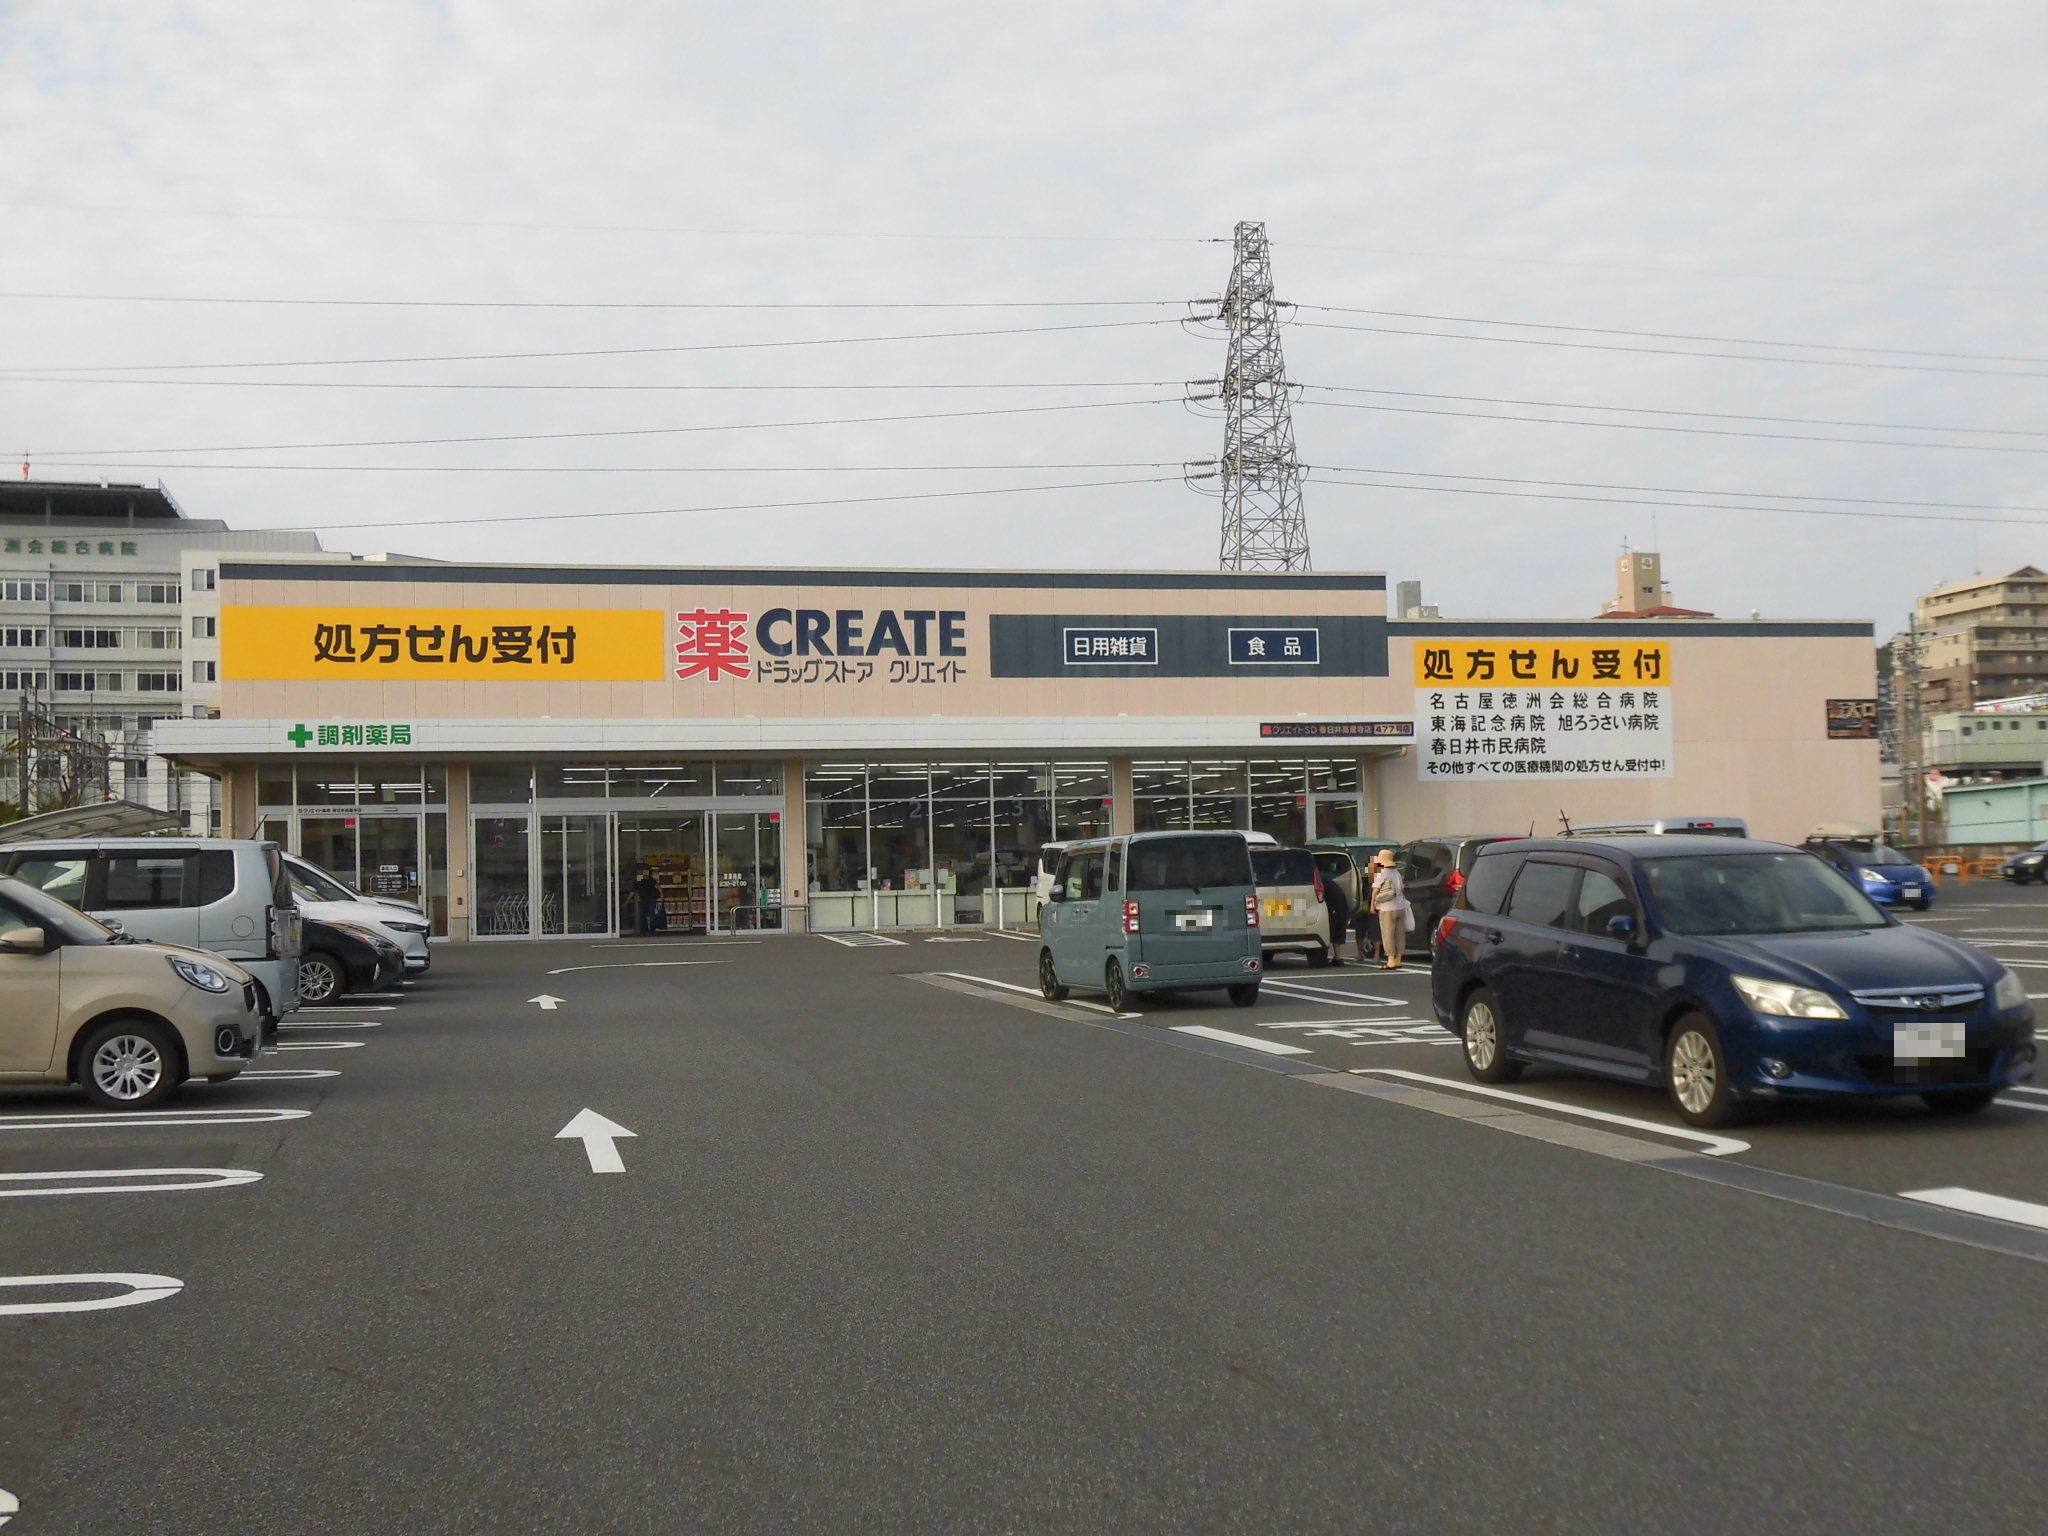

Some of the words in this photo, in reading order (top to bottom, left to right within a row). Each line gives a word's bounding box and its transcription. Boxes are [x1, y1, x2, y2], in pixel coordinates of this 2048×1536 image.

[314, 623, 576, 664] 処方せん受付
[755, 607, 967, 657] CREATE
[674, 607, 752, 683] 薬
[1073, 637, 1148, 657] 日用雑貨
[756, 659, 874, 684] ドラッグストア
[889, 660, 967, 684] クリエイト
[1423, 649, 1662, 680] 処方せん受付
[1430, 692, 1660, 710] 名古屋徳洲会総合病院
[1430, 715, 1546, 733] 東海記念病院
[1558, 713, 1660, 732] 旭ろうさい病院
[318, 724, 412, 746] 調剤薬局
[1431, 737, 1547, 756] 春日井市民病院
